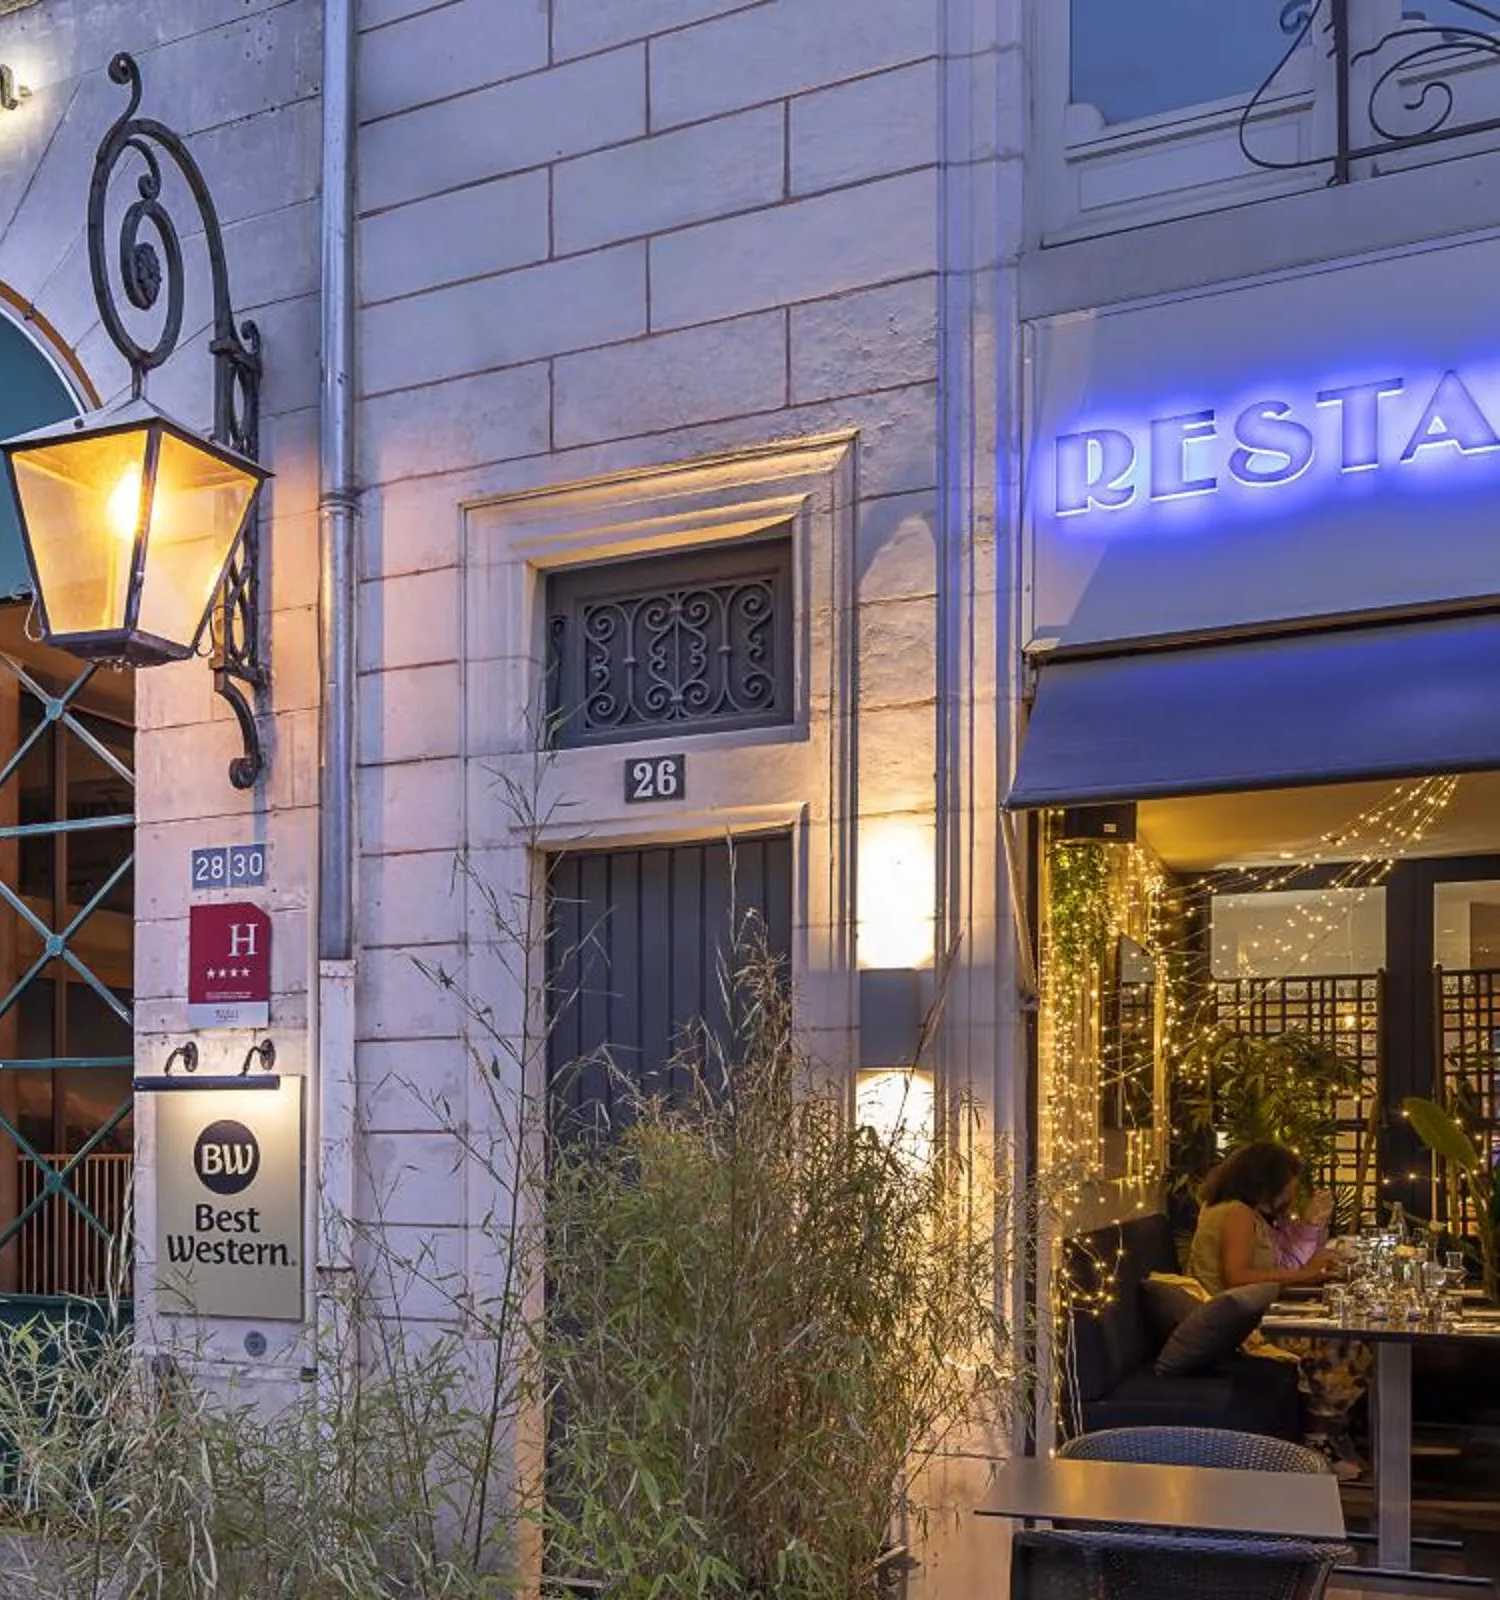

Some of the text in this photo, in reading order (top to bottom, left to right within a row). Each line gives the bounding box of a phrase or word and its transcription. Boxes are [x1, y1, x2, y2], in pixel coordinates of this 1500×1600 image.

[1055, 369, 1500, 518] RESTA
[633, 760, 677, 798] 26
[195, 852, 263, 881] 28 30
[228, 923, 259, 957] H
[200, 1143, 253, 1176] BW
[195, 1203, 261, 1234] Best
